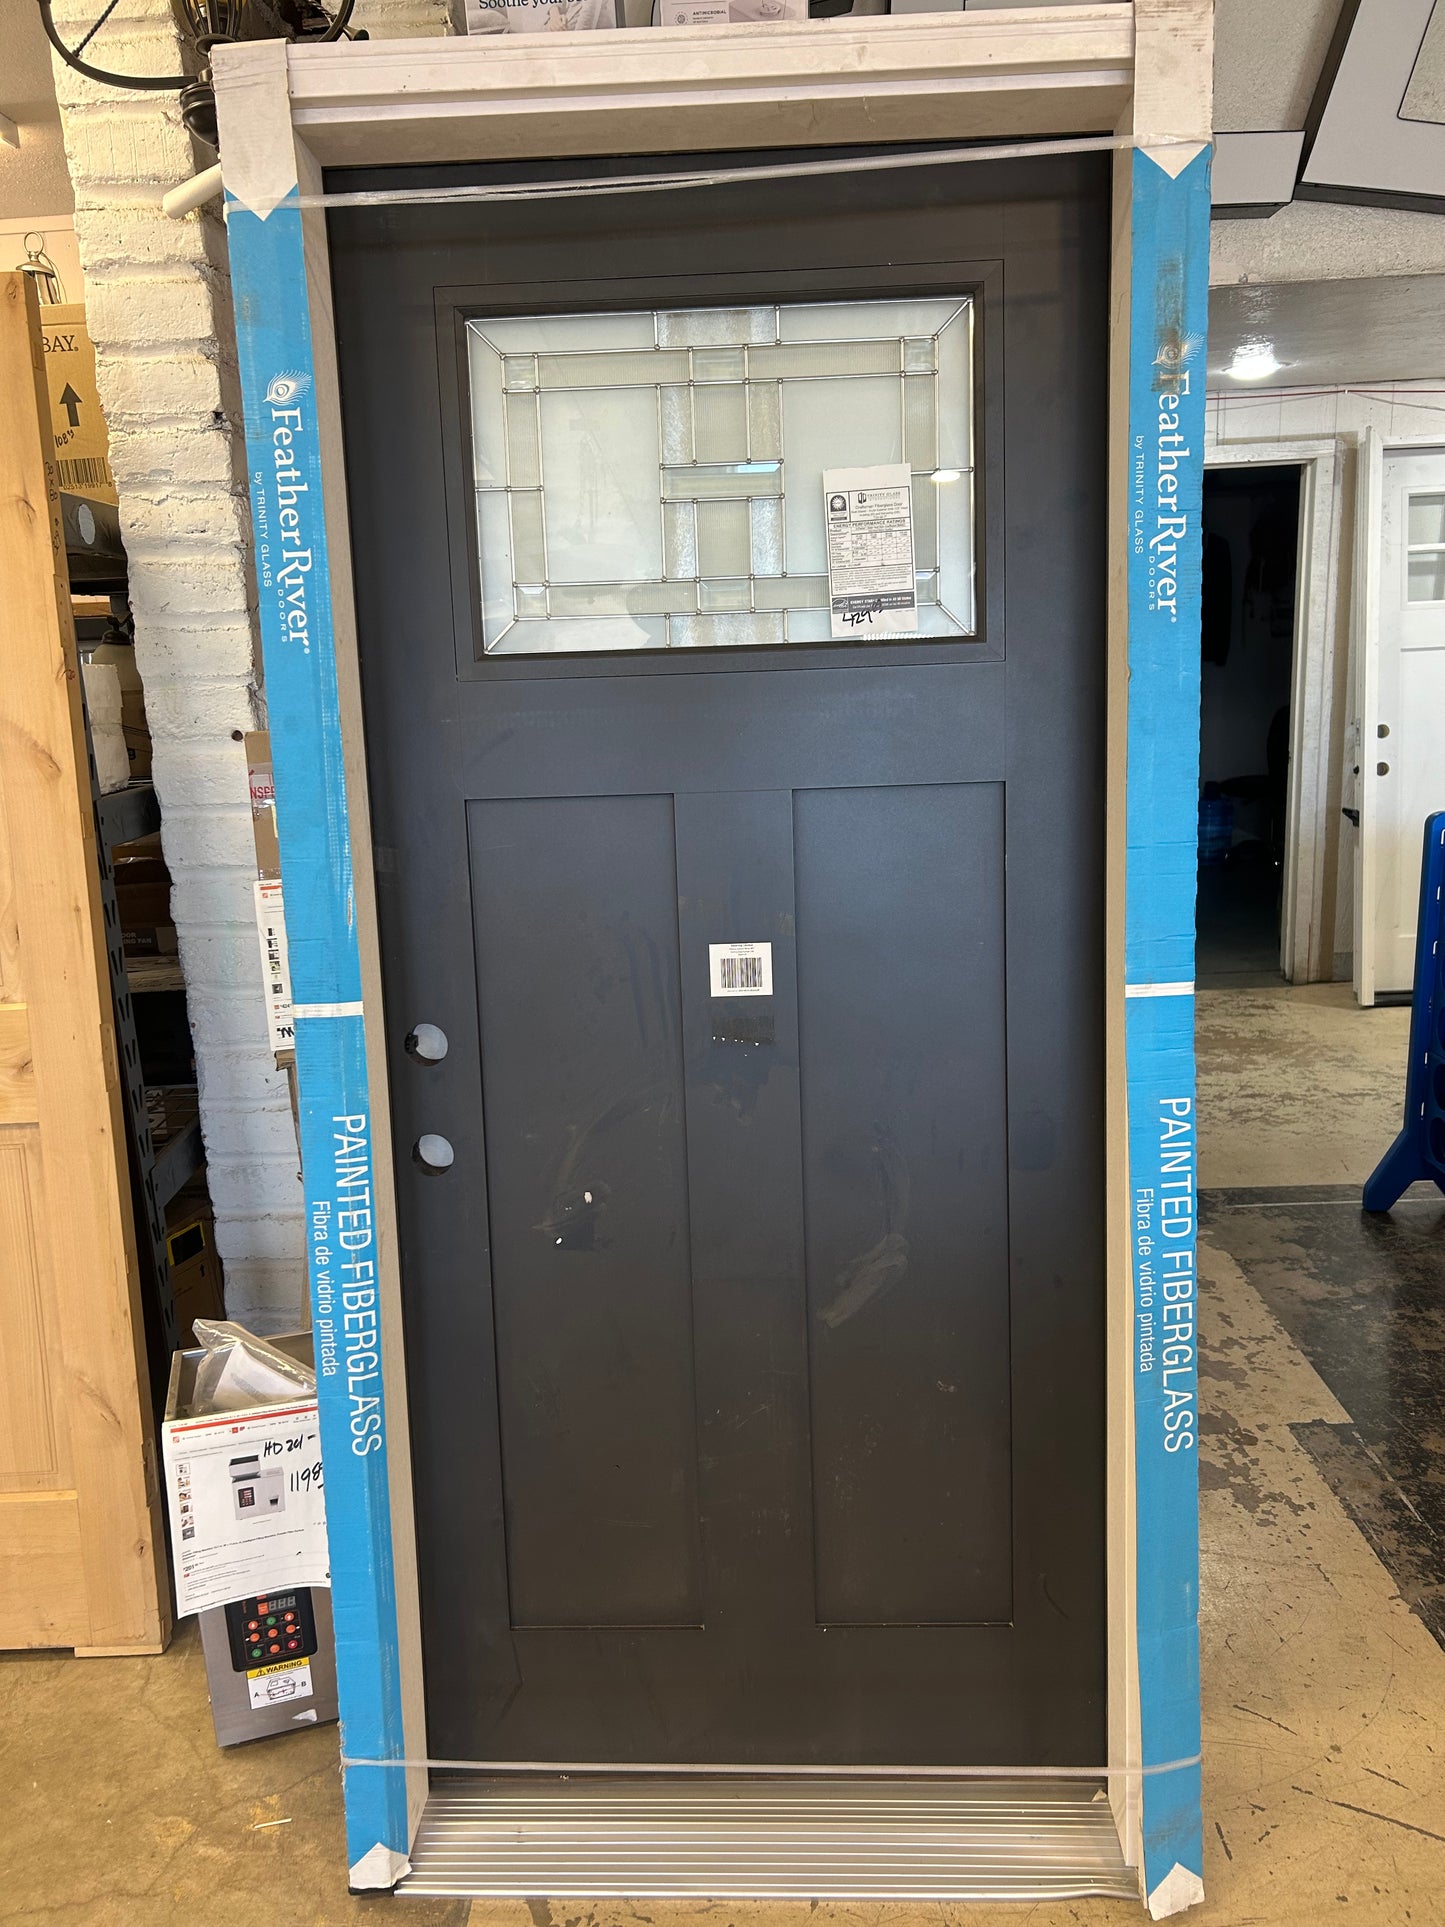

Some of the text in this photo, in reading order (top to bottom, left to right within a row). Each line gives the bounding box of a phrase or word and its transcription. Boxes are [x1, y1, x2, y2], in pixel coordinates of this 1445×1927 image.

[253, 471, 273, 588] by TRINITY GLASS
[1134, 435, 1145, 554] by TRINITY GLASS
[277, 588, 288, 643] DOORS
[1148, 555, 1156, 611] DOORS
[312, 1200, 338, 1377] Fibra de vidrio pintada
[332, 1114, 383, 1456] PAINTED FIBERGLASS
[1136, 1188, 1156, 1373] Fibra de vidrio pintada
[1160, 1097, 1194, 1453] PAINTED FIBERGLASS
[266, 1659, 303, 1674] WARNING
